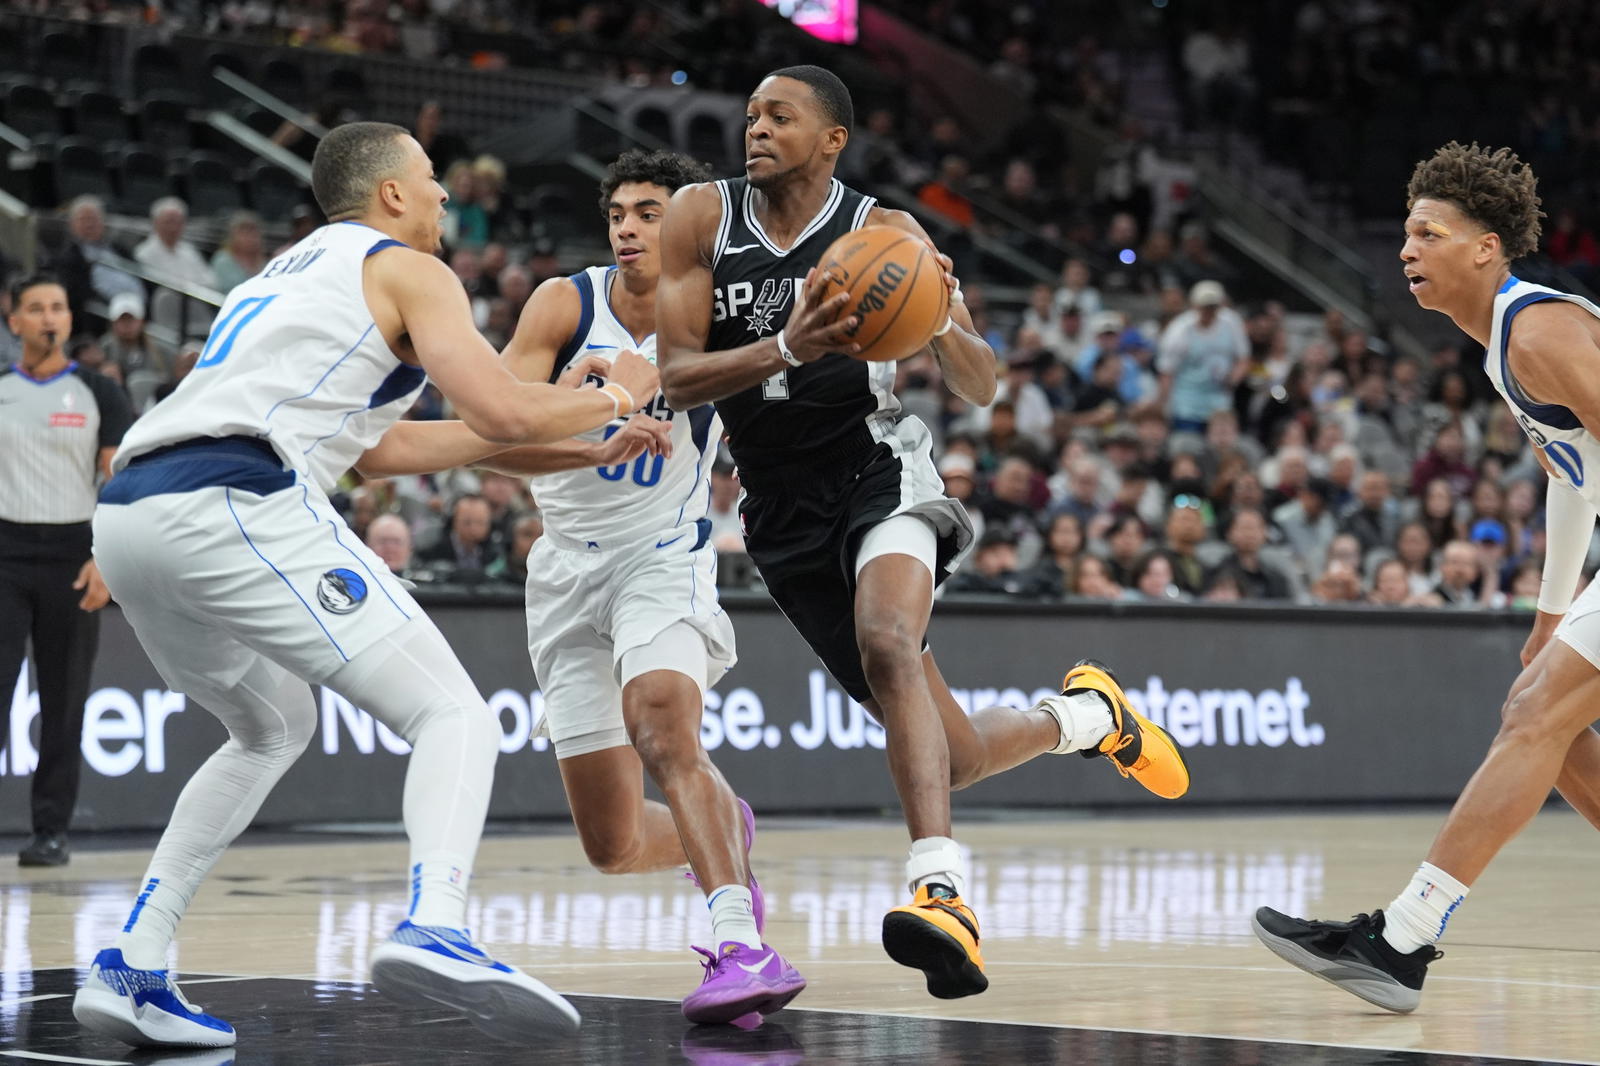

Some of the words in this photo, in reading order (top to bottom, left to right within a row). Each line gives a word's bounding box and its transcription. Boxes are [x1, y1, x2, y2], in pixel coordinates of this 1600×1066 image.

[195, 293, 281, 369] 0
[0, 655, 186, 778] ber
[1124, 674, 1325, 748] ternet.
